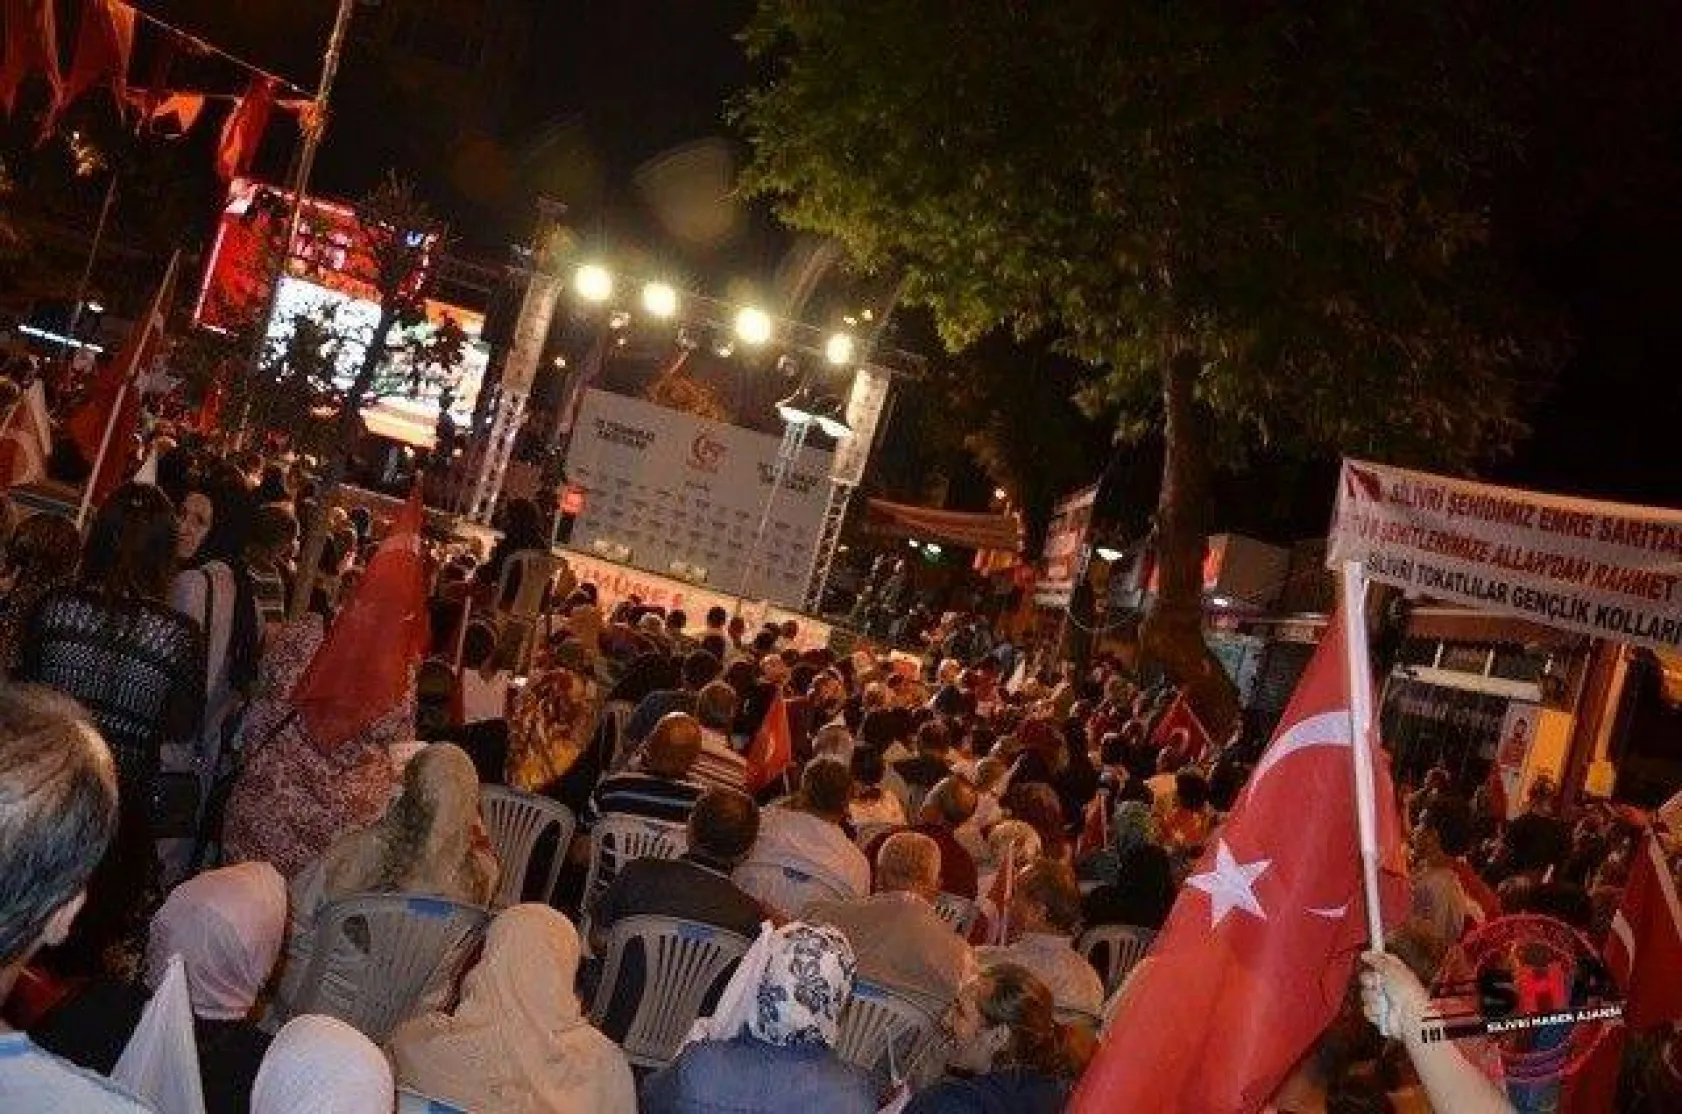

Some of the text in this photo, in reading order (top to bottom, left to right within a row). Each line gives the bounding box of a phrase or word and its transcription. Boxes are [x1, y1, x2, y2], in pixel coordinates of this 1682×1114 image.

[1539, 507, 1594, 538] EMRE
[1416, 564, 1507, 603] TOKATLILAR
[1512, 586, 1590, 624] GENÇLİK
[1592, 563, 1678, 601] RAHMET
